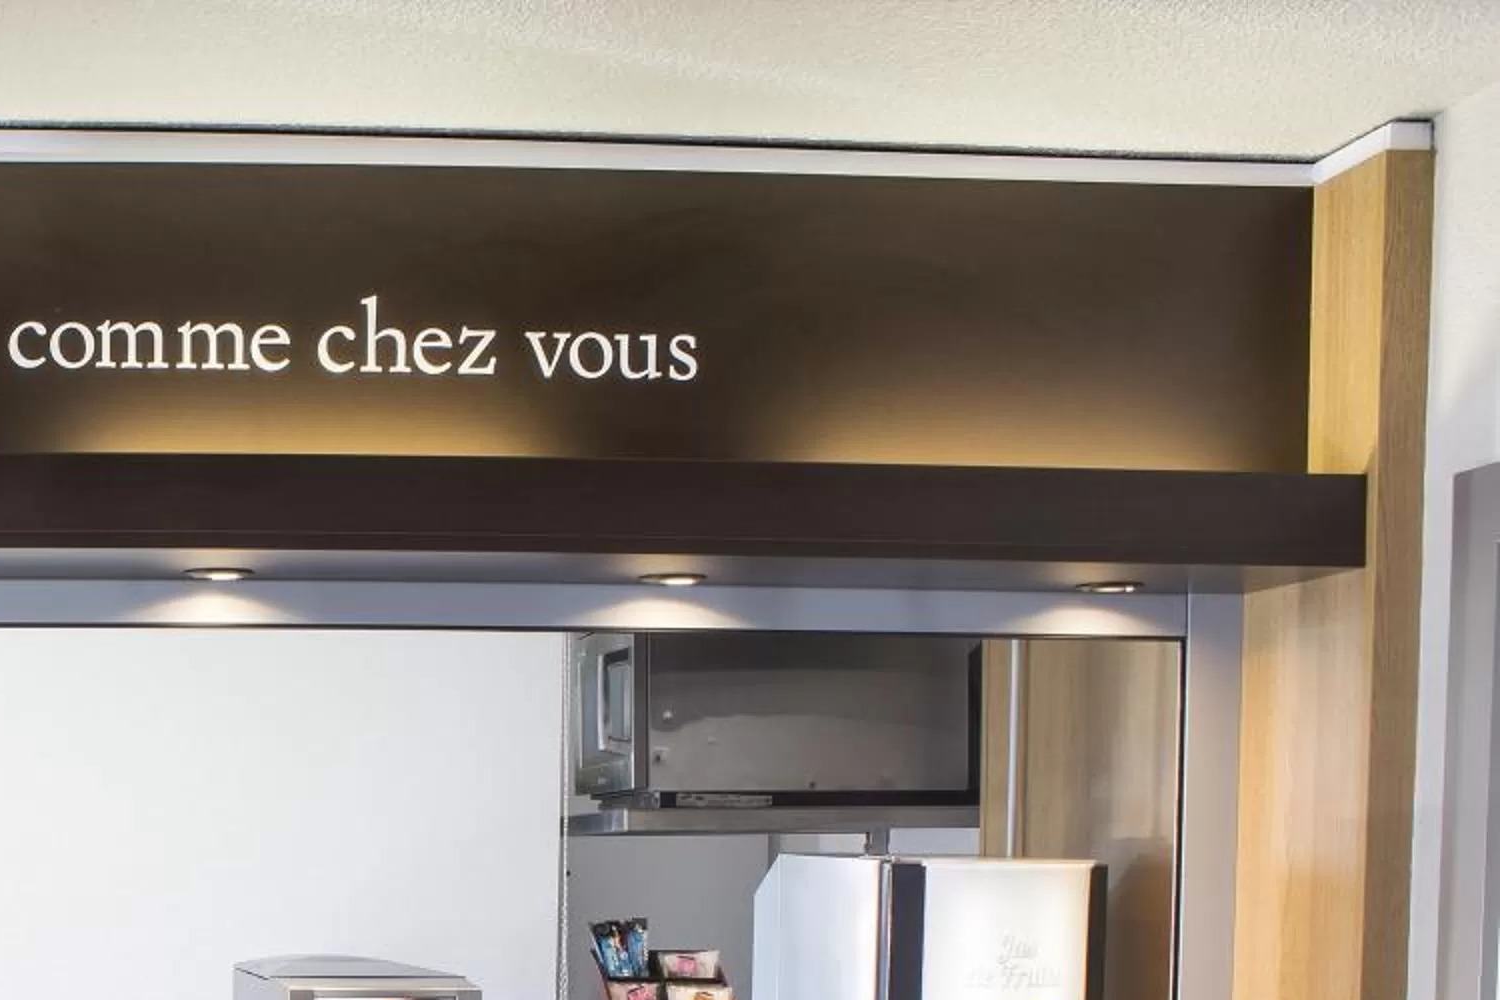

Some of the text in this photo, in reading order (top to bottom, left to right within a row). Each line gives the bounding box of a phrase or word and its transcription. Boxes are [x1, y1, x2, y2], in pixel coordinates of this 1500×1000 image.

[8, 319, 291, 373] comme
[317, 295, 497, 375] chez
[525, 331, 697, 381] vous
